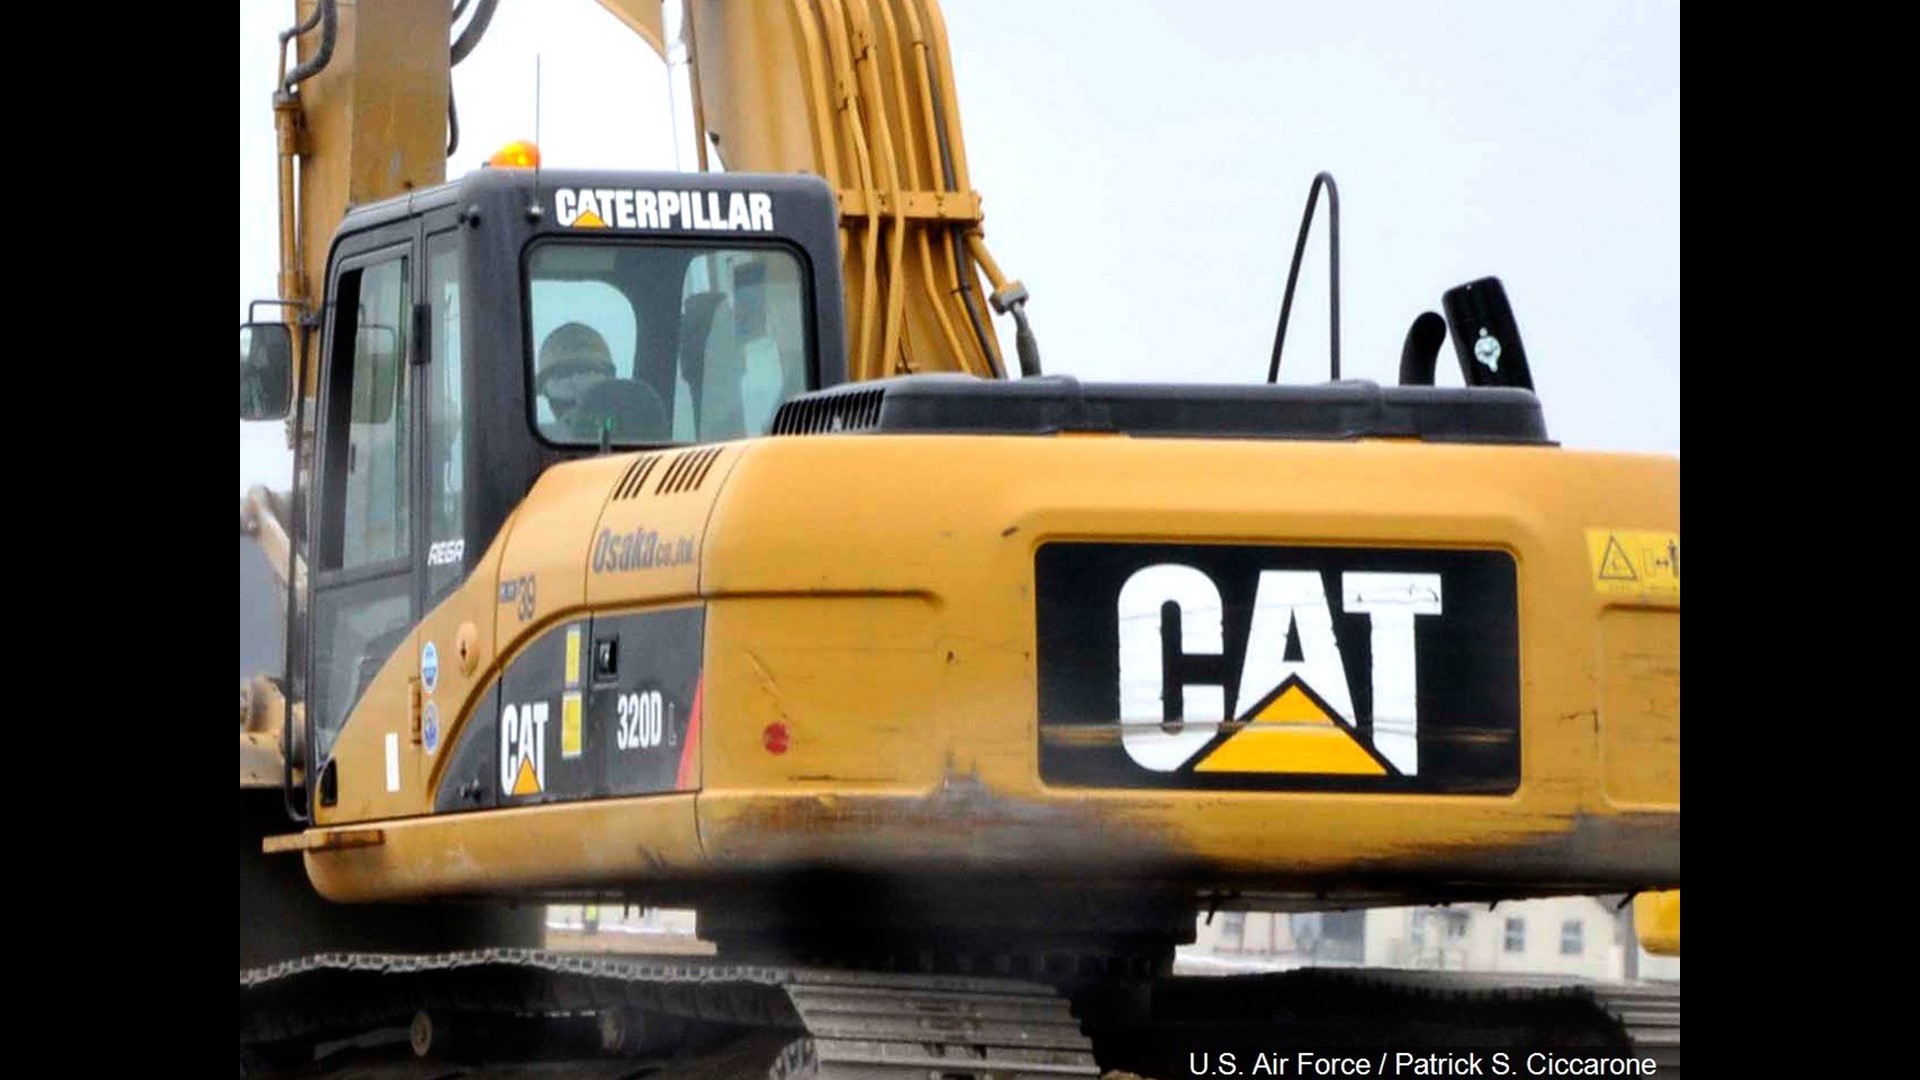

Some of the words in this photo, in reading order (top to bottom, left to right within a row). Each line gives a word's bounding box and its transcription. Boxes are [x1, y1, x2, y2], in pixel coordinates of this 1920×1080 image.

[555, 188, 774, 231] CATERPILLAR
[592, 527, 656, 573] Osaka
[1118, 563, 1443, 776] CAT
[502, 702, 549, 796] CAT
[616, 690, 663, 750] 320D
